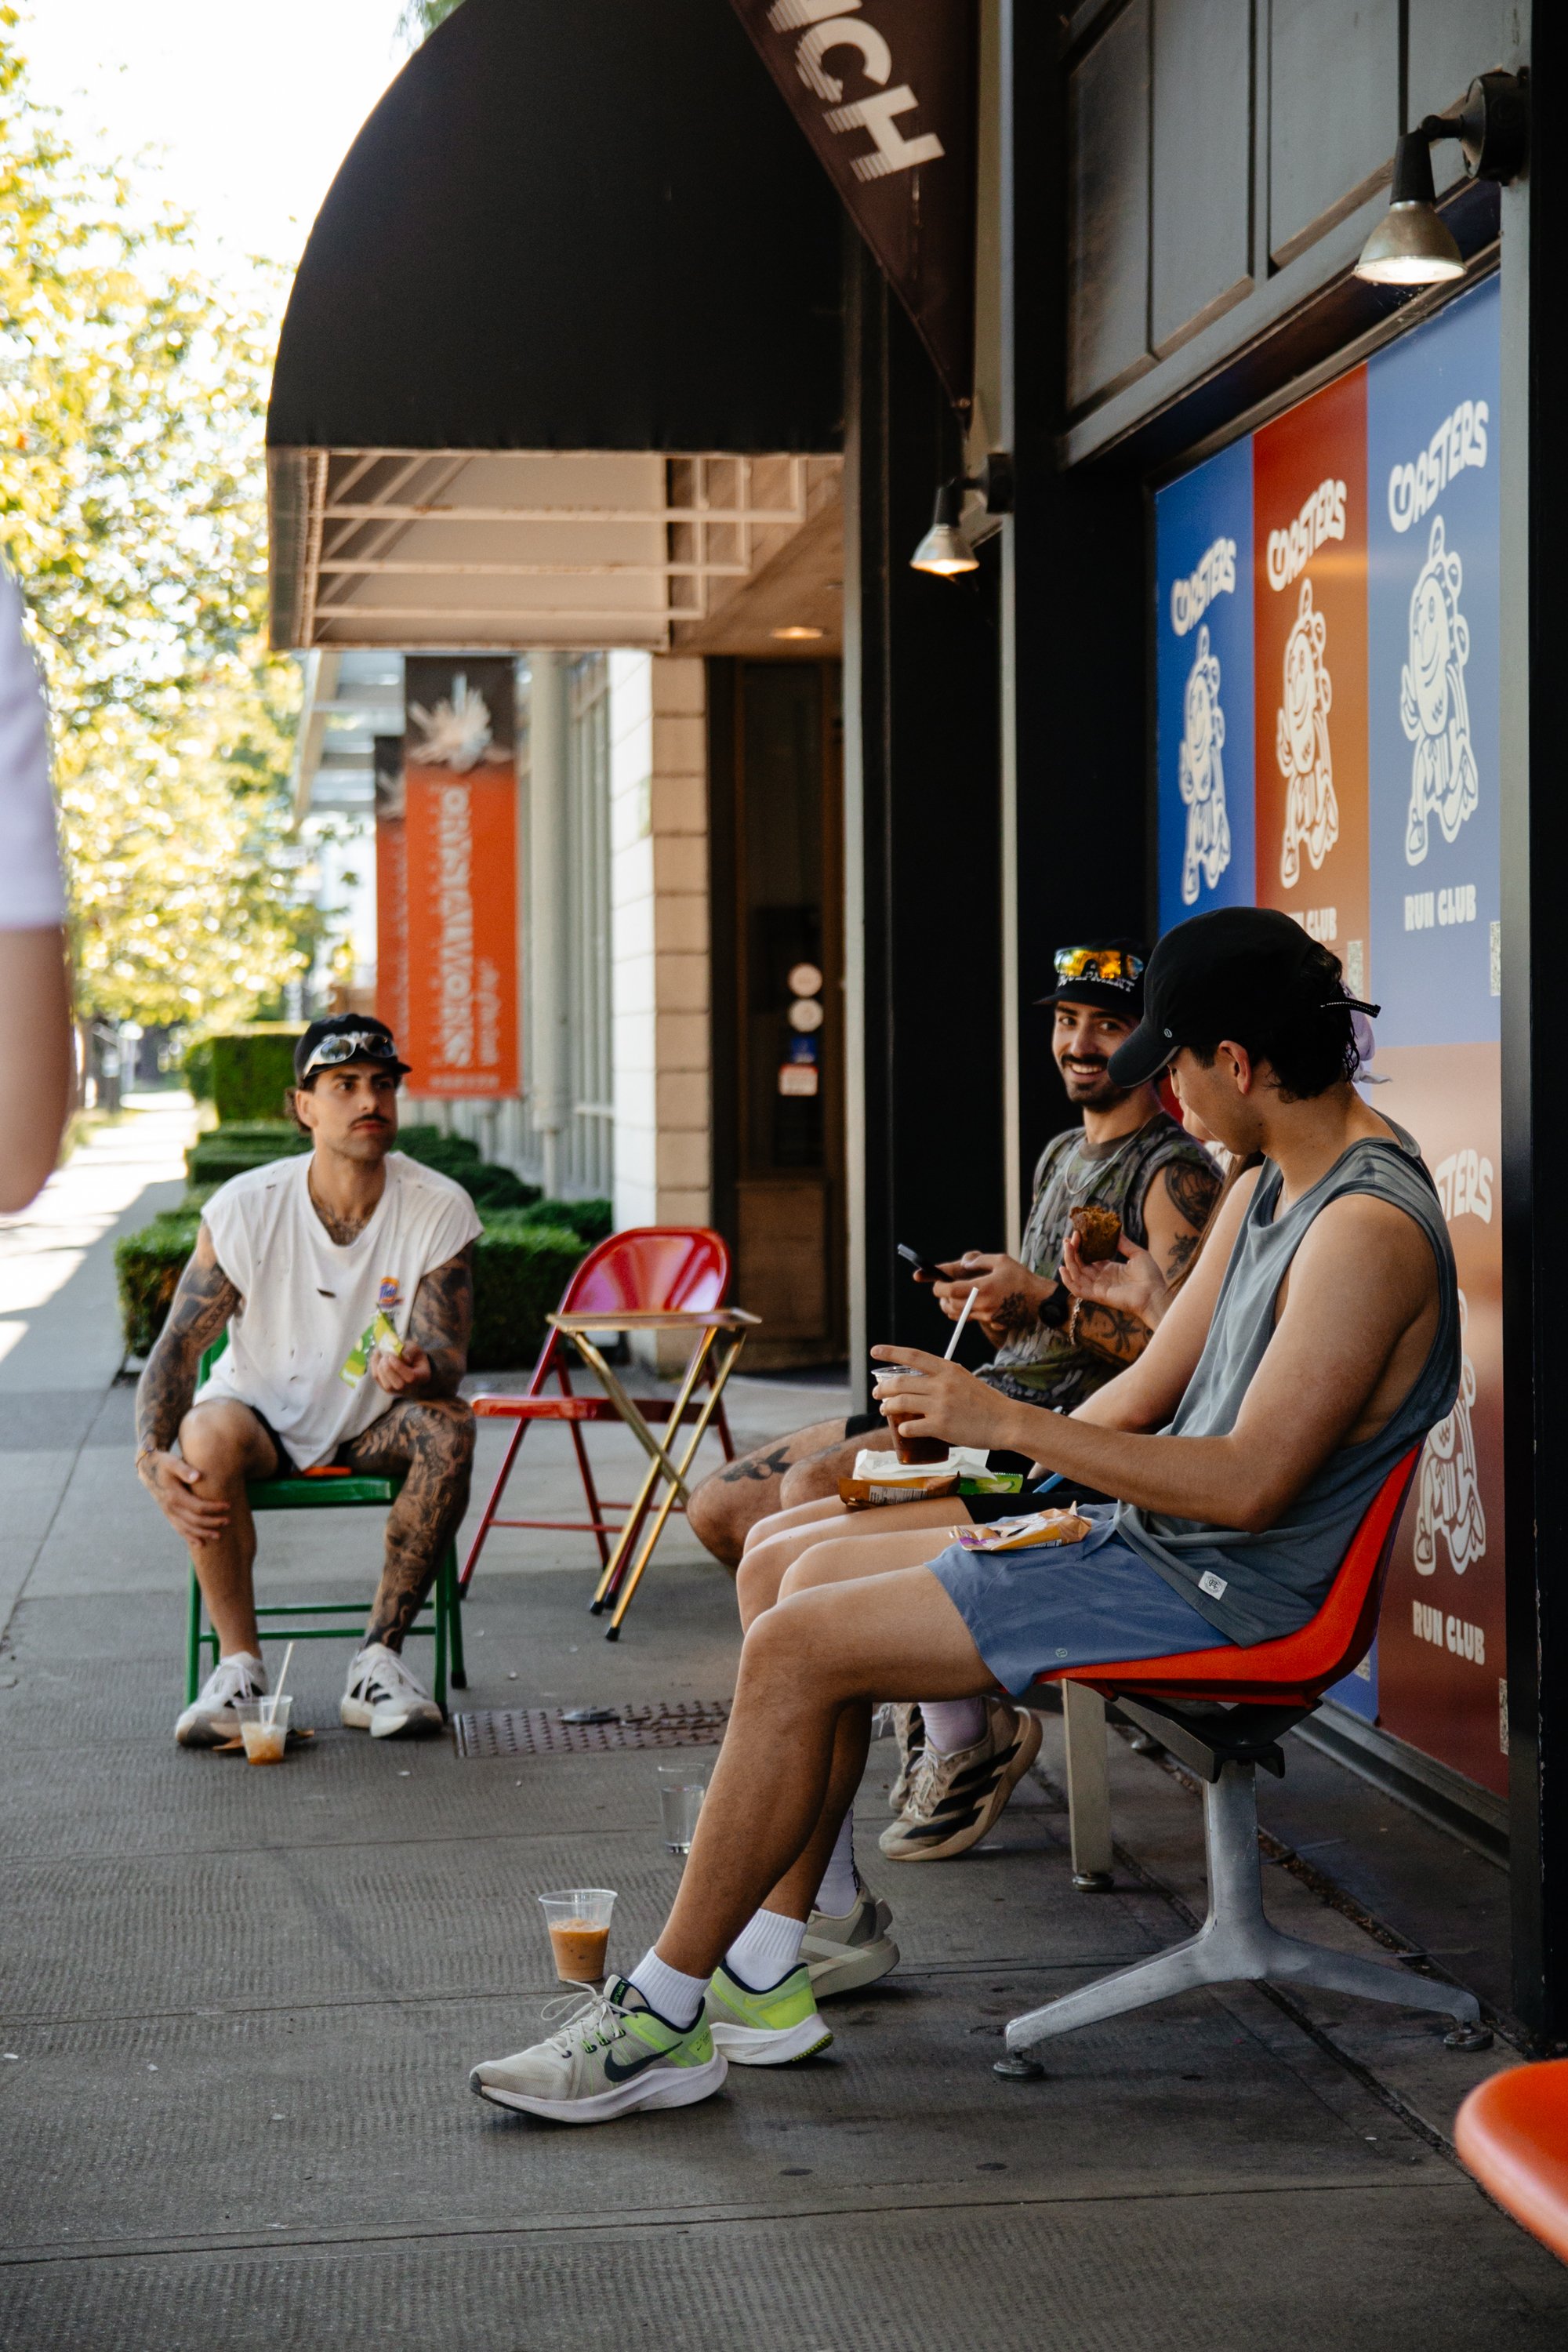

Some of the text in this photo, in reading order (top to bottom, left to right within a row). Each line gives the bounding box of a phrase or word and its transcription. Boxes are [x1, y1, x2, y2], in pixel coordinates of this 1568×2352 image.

[1388, 401, 1489, 533] COASTERS
[1267, 478, 1347, 592] COASTERS
[1171, 537, 1236, 637] COASTERS
[1405, 884, 1476, 931] RUN CLUB
[1434, 1149, 1494, 1224] STERS
[1413, 1600, 1485, 1666] RUN CLUB
